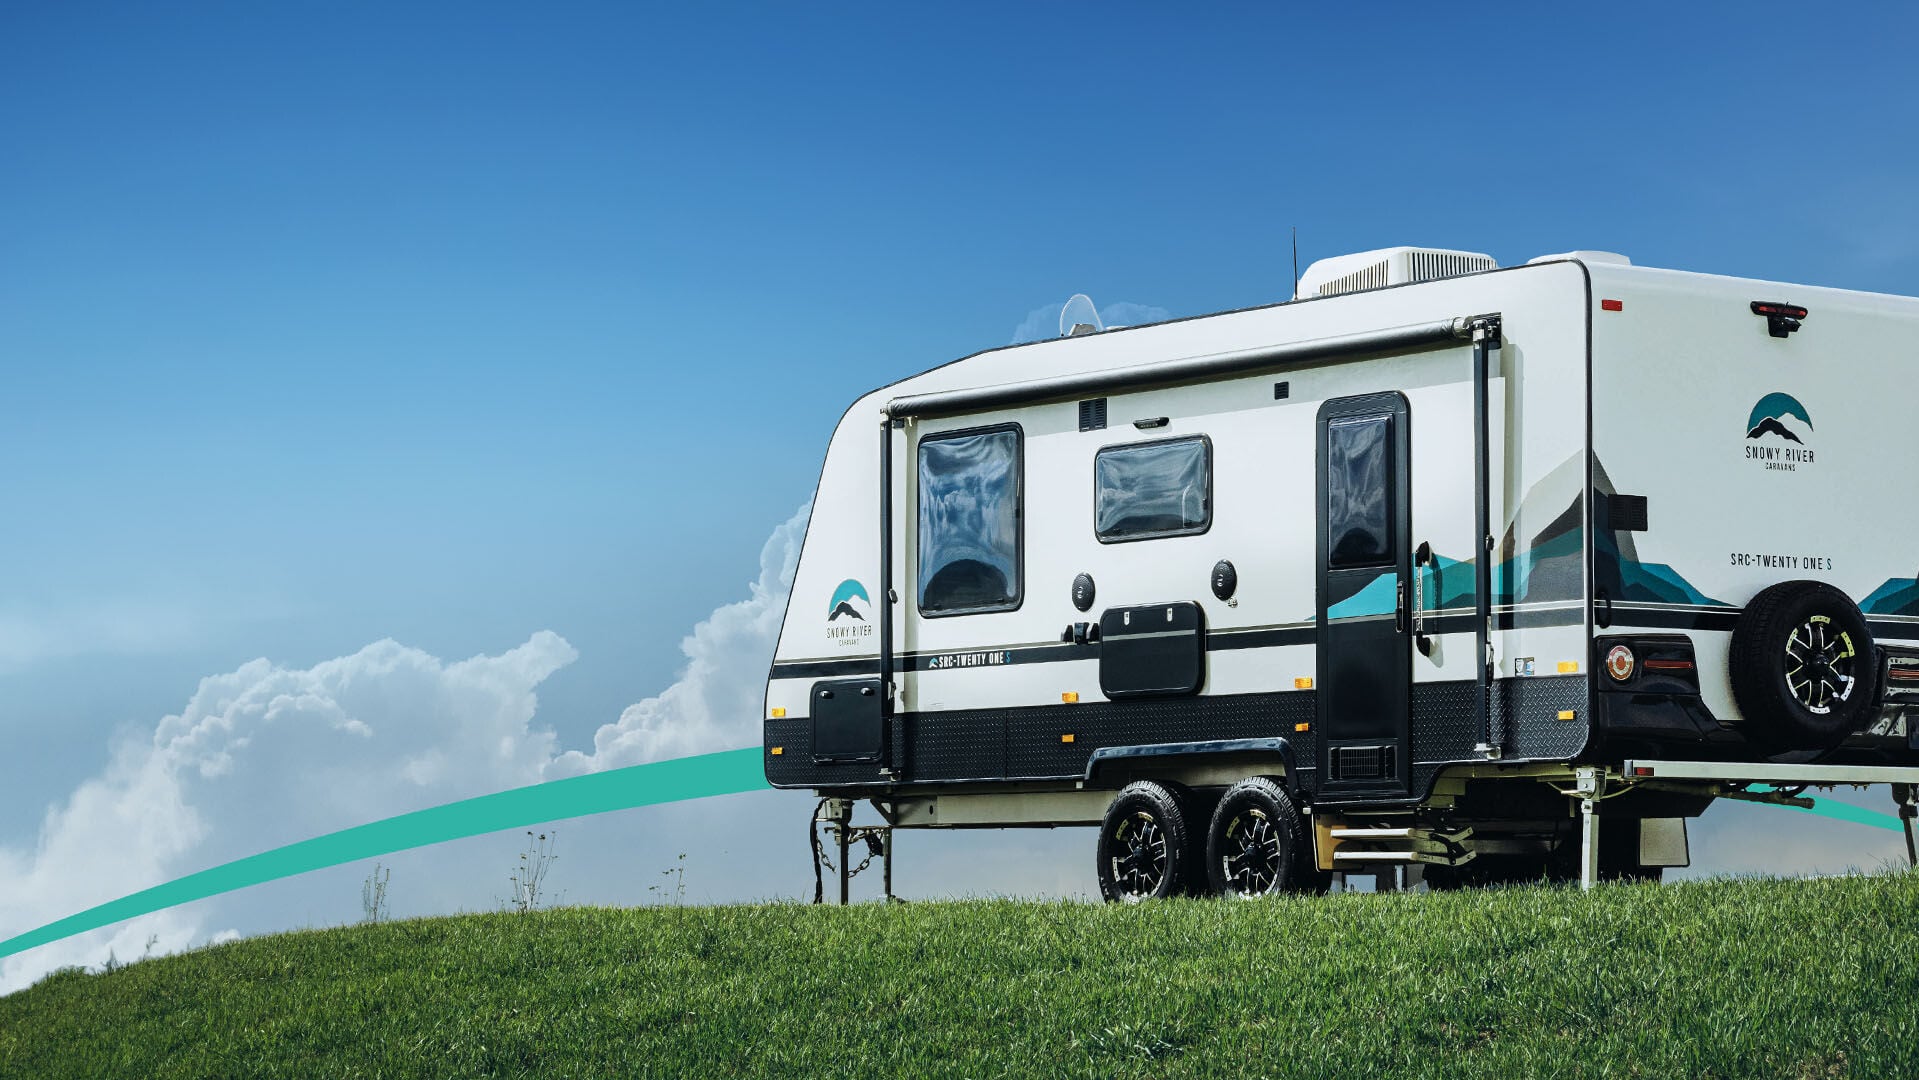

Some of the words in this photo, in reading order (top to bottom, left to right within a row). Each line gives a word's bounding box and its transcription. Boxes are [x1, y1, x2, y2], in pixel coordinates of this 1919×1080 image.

[1745, 445, 1780, 460] SNOWY
[1785, 448, 1815, 463] RIVER
[1765, 462, 1796, 472] CARAVANS
[1730, 553, 1798, 569] SRC-TWENTY
[1803, 556, 1823, 570] ONE
[1826, 558, 1832, 570] S
[826, 626, 850, 639] SNOWY
[852, 625, 872, 637] RIVER
[939, 653, 986, 668] SRC-TWENTY
[988, 651, 1004, 664] ONE
[1005, 651, 1011, 664] S
